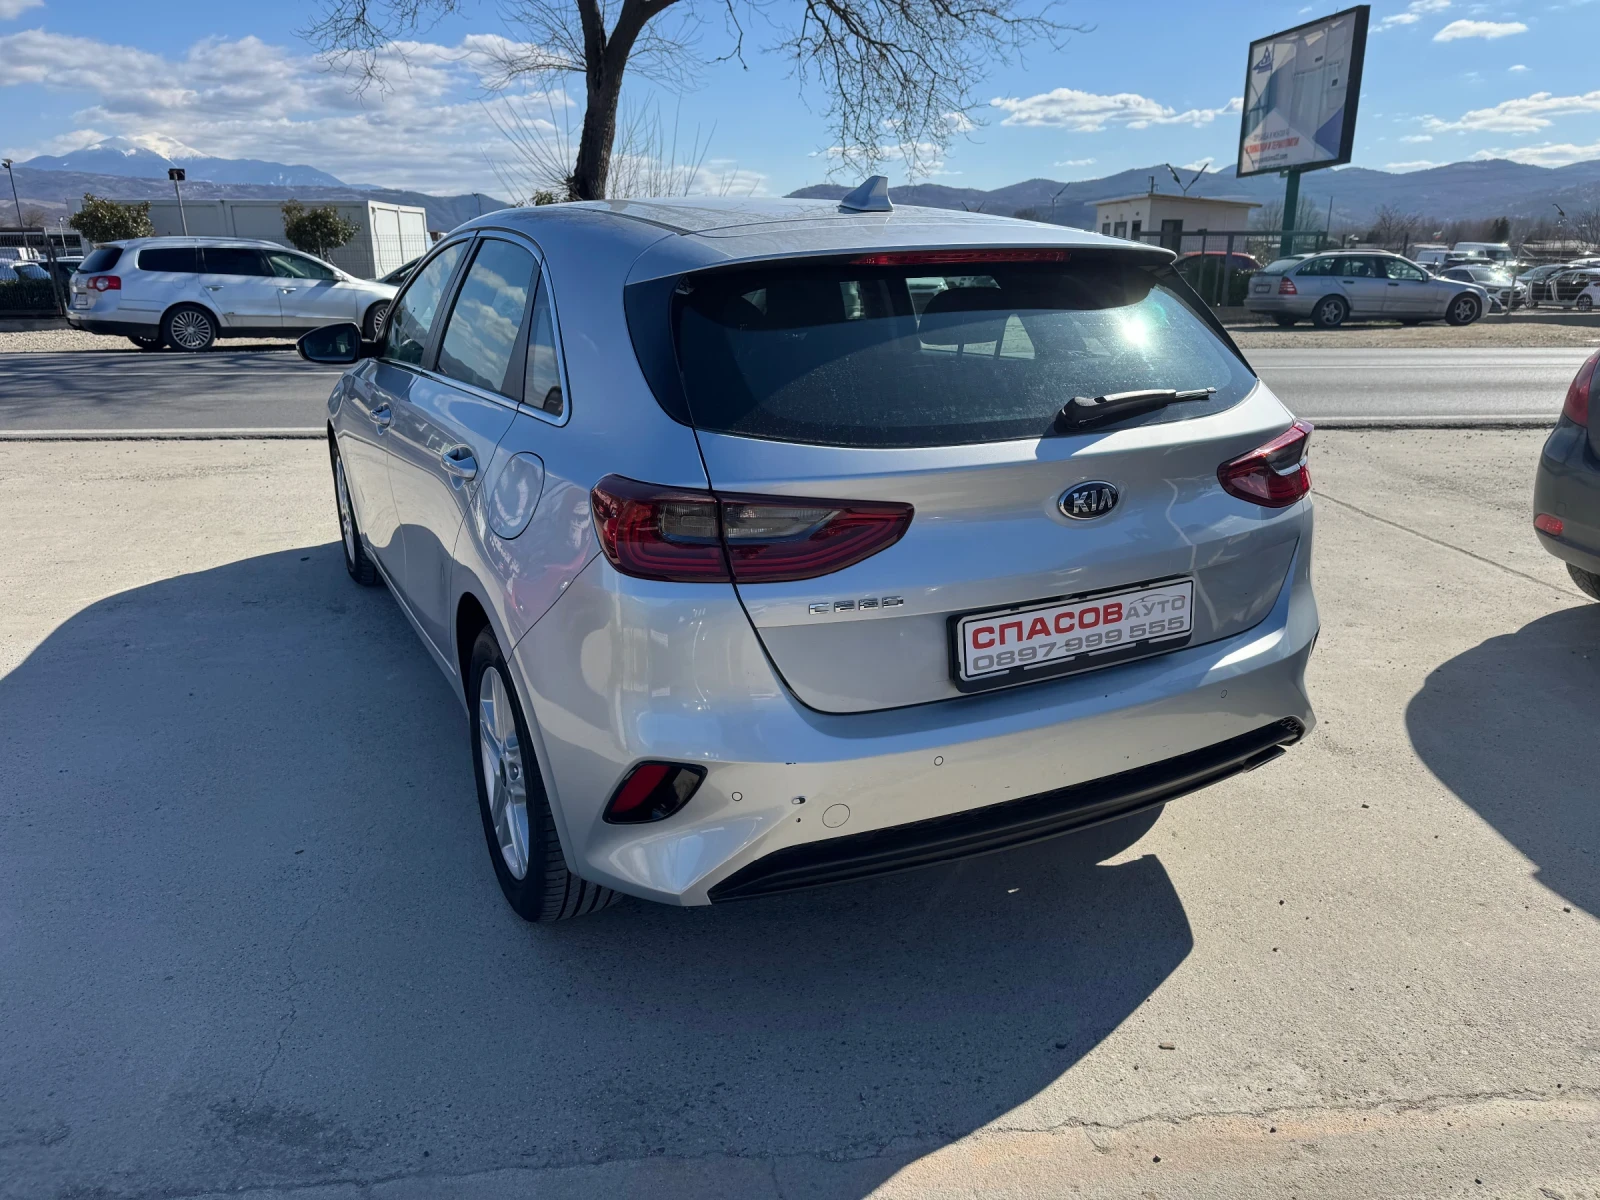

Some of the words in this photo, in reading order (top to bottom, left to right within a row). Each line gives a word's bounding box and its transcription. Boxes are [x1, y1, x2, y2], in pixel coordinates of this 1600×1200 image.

[1072, 488, 1113, 514] KIA
[972, 602, 1123, 650] СПАСОВ
[1124, 597, 1186, 621] АУТО
[1129, 616, 1185, 639] 555
